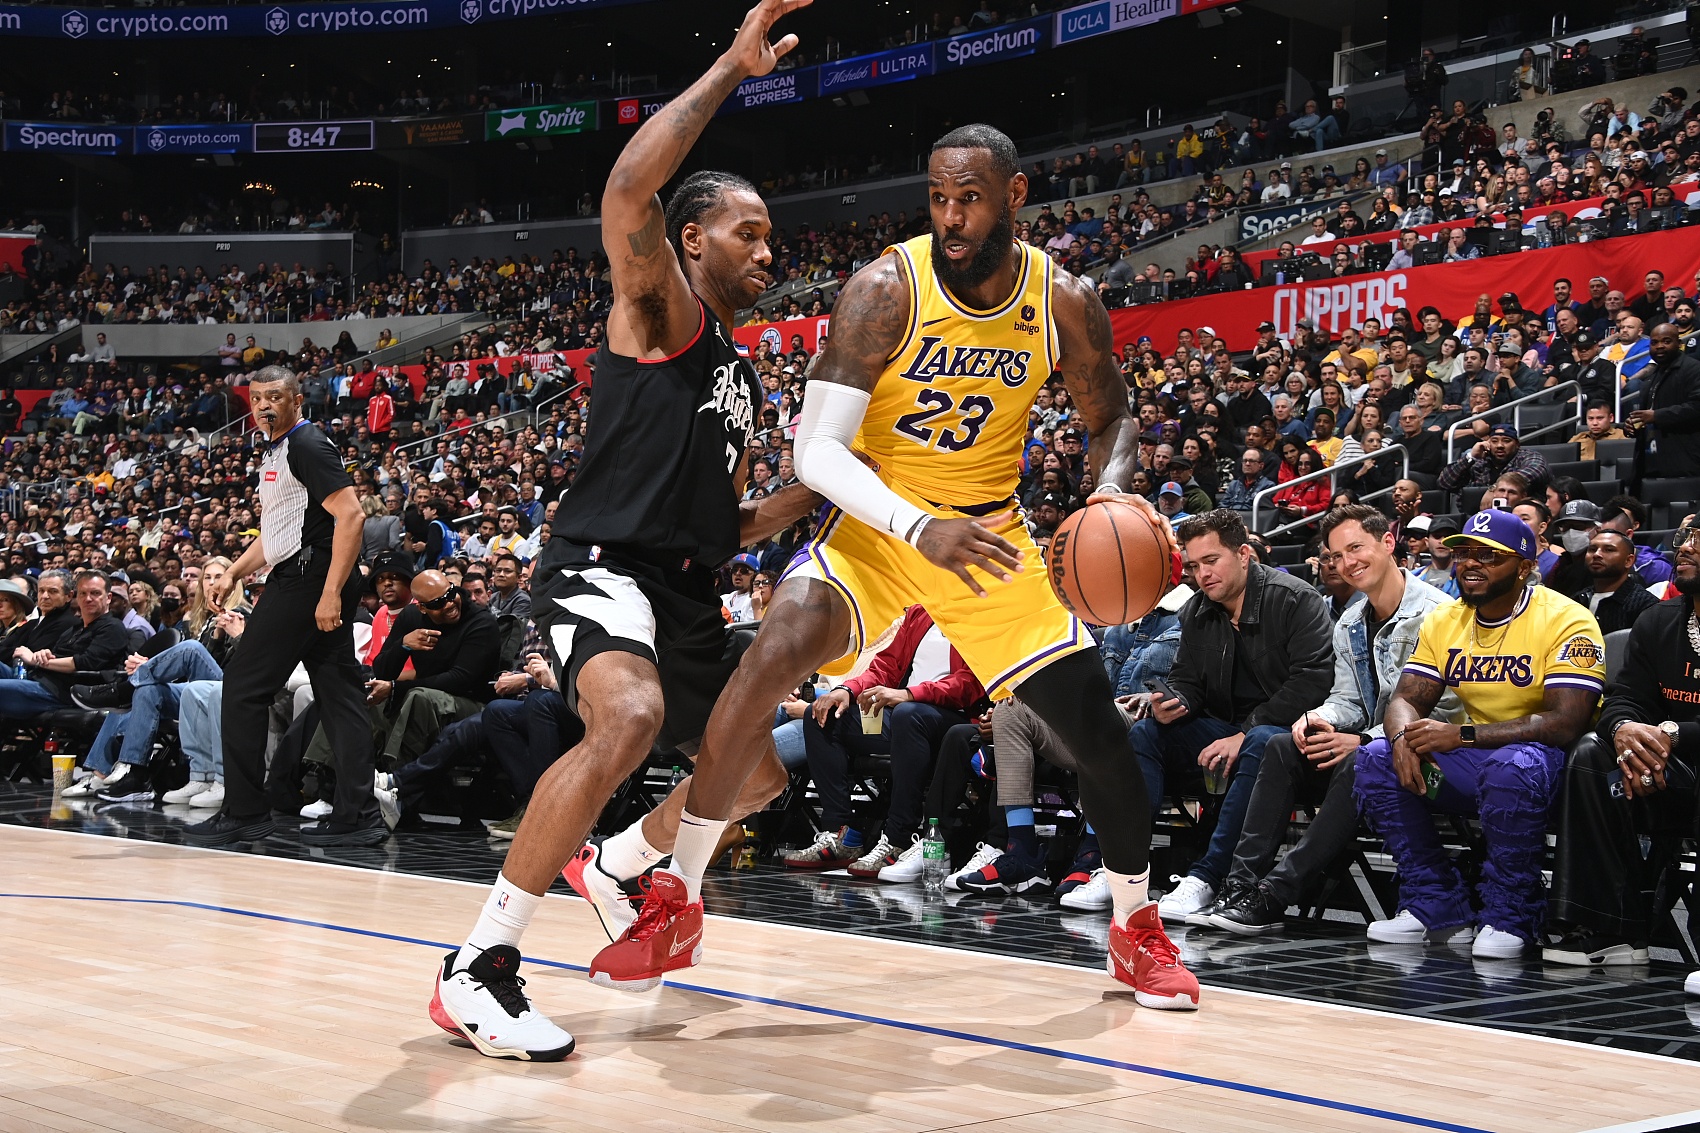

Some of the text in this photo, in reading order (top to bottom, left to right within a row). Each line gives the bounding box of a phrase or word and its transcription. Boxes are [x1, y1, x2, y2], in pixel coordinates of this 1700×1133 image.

[96, 14, 228, 37] crypto.com
[297, 6, 428, 30] crypto.com
[1068, 11, 1104, 33] UCLA
[946, 27, 1035, 65] Spectrum
[824, 53, 927, 87] Michelob ULTRA
[736, 75, 795, 97] AMERICAN
[744, 87, 796, 107] EXPRESS
[536, 107, 586, 132] Sprite
[20, 127, 116, 148] Spectrum
[169, 132, 240, 148] crypto.com
[287, 126, 341, 147] 8:47
[1273, 273, 1407, 341] CLIPPERS
[1013, 321, 1040, 335] bibigo
[899, 336, 1032, 388] LAKERS
[891, 388, 996, 454] 23
[1051, 530, 1077, 611] Wilson
[1557, 643, 1605, 664] LAKERS
[1444, 647, 1535, 688] LAKERS
[1684, 662, 1691, 677] I
[1659, 681, 1700, 704] enerati
[923, 843, 937, 854] ite
